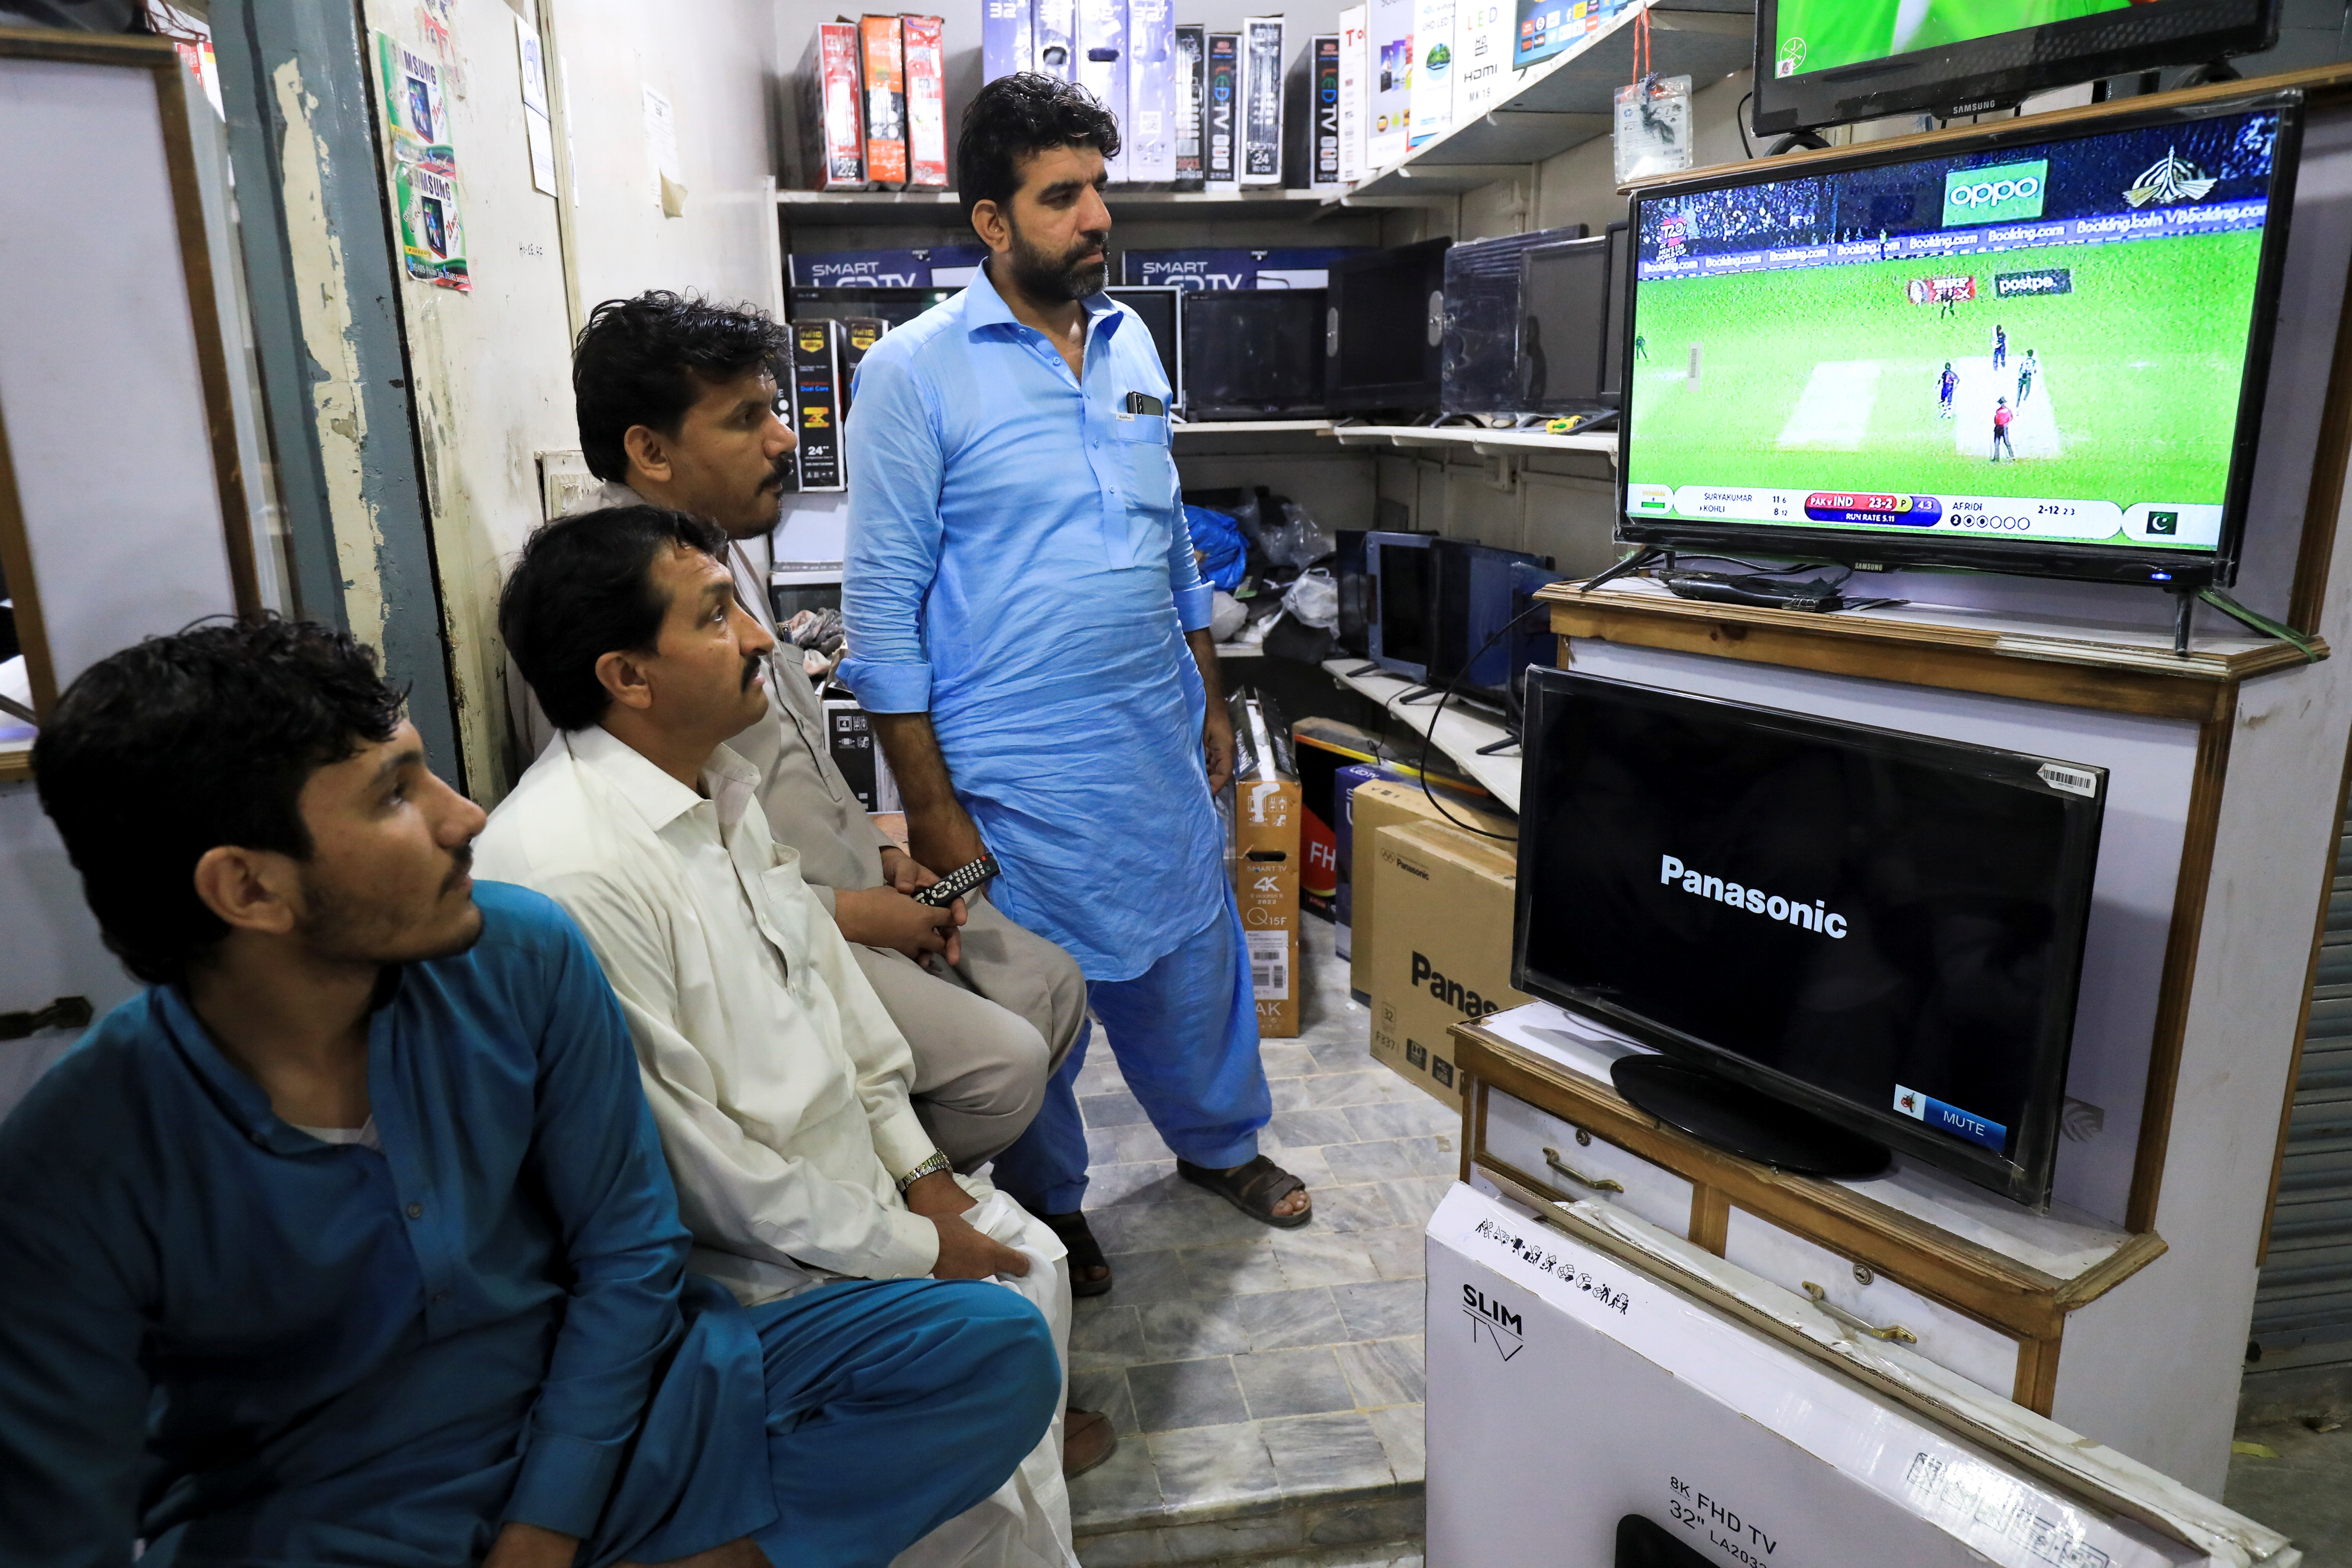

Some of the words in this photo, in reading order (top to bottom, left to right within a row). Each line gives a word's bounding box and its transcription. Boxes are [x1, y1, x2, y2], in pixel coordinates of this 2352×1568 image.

[1468, 7, 1497, 30] LED
[1476, 35, 1486, 47] HD
[1464, 64, 1497, 83] HDMI
[1214, 66, 1231, 100] LED
[1953, 100, 1996, 114] SAMSUNG
[1214, 102, 1230, 129] TV
[1321, 104, 1337, 132] TV
[1254, 153, 1269, 165] 24
[1988, 226, 2065, 241] Booking.com
[1909, 234, 1978, 249] Booking.com
[1769, 248, 1829, 261] Booking.com
[812, 262, 879, 277] SMART
[1142, 261, 1208, 274] SMART
[1704, 493, 1752, 502] SURYAKUMAR
[1810, 497, 1826, 506] PAK
[1833, 496, 1854, 508] IND
[1868, 497, 1893, 509] 23-2
[1918, 501, 1933, 510] 4.3
[1952, 502, 1983, 512] AFRIDI
[2038, 505, 2059, 515] 2-12
[1862, 514, 1881, 522] RATE
[1855, 562, 1883, 571] SAMSUNG
[1397, 858, 1430, 881] Panasonic
[1253, 876, 1280, 892] 4K
[1661, 853, 1848, 939] Panasonic
[1385, 1008, 1393, 1022] 32
[1943, 1110, 1986, 1136] MUTE
[1463, 1283, 1522, 1336] SLIM
[1671, 1476, 1690, 1498] 8K
[1698, 1492, 1741, 1533] FHD
[1748, 1524, 1777, 1555] TV
